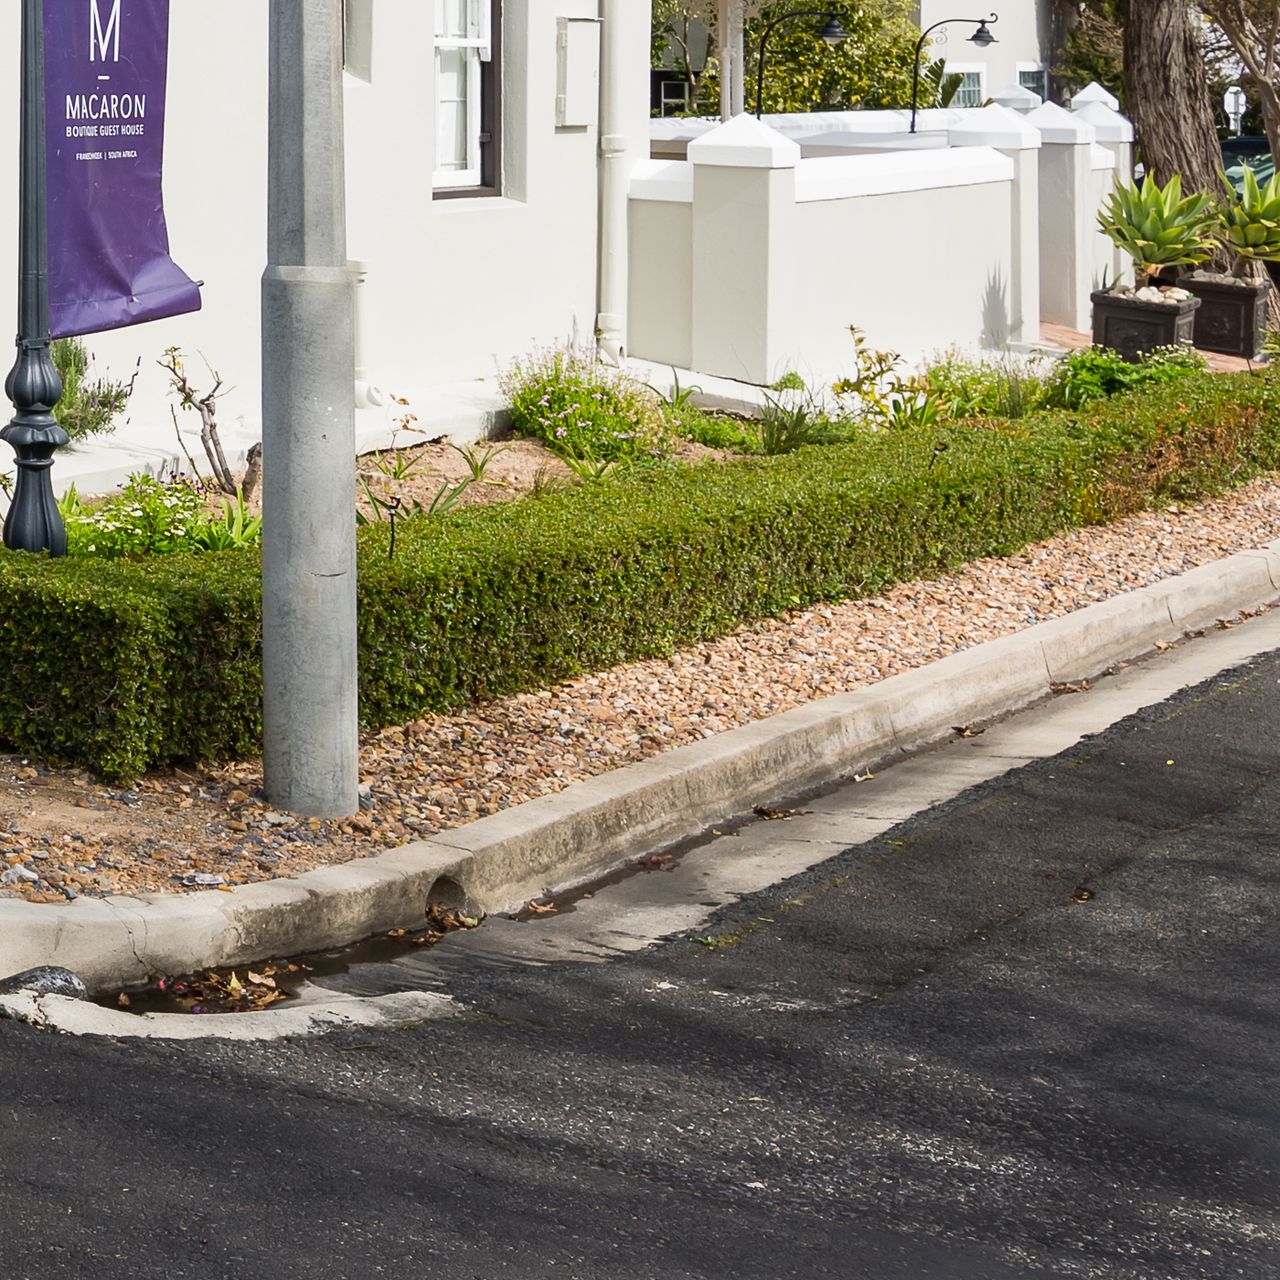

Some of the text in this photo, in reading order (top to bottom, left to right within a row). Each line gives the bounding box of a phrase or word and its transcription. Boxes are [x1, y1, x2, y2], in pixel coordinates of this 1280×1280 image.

[65, 94, 146, 119] MACARON
[99, 125, 120, 136] GUEST
[121, 124, 144, 135] HOUSE
